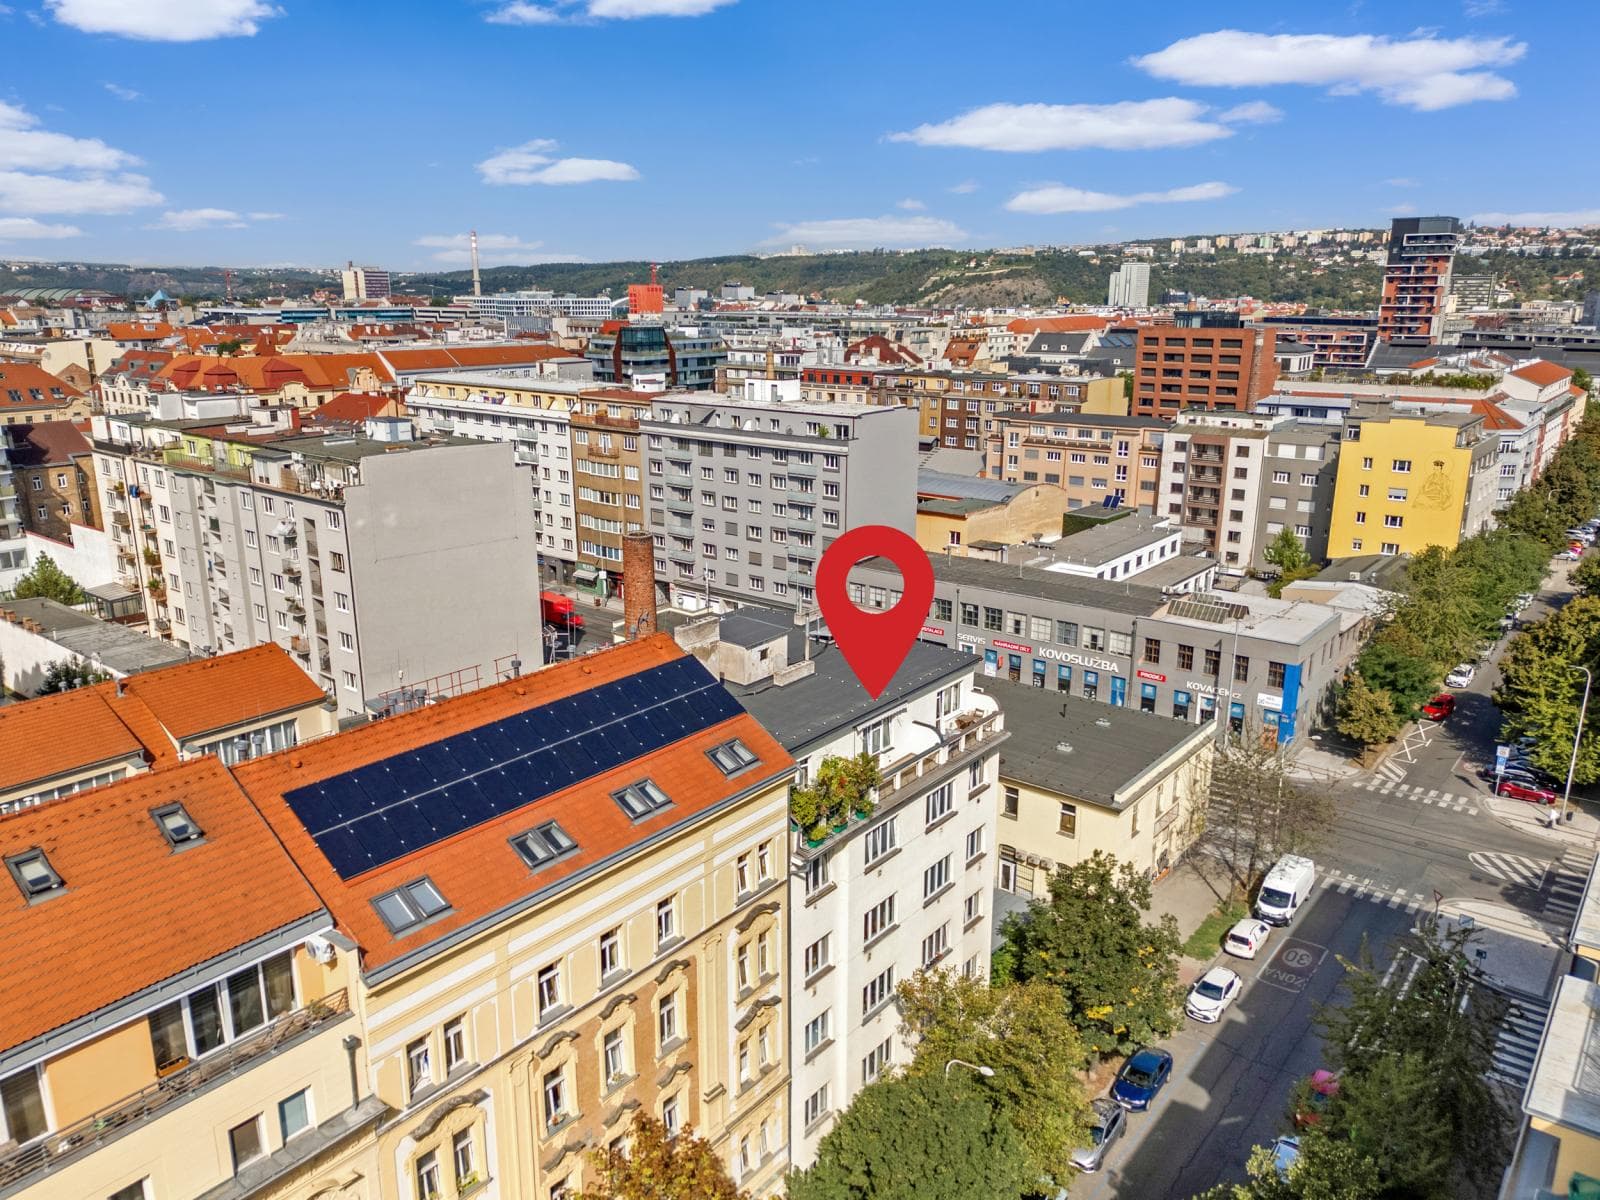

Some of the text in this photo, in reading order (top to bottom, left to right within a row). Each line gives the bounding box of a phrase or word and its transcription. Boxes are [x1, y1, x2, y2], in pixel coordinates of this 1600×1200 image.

[957, 632, 986, 645] SERVIS
[1038, 647, 1119, 673] KOVOSLUŽBA
[1140, 671, 1164, 681] PRODEJ
[1285, 950, 1310, 966] 30
